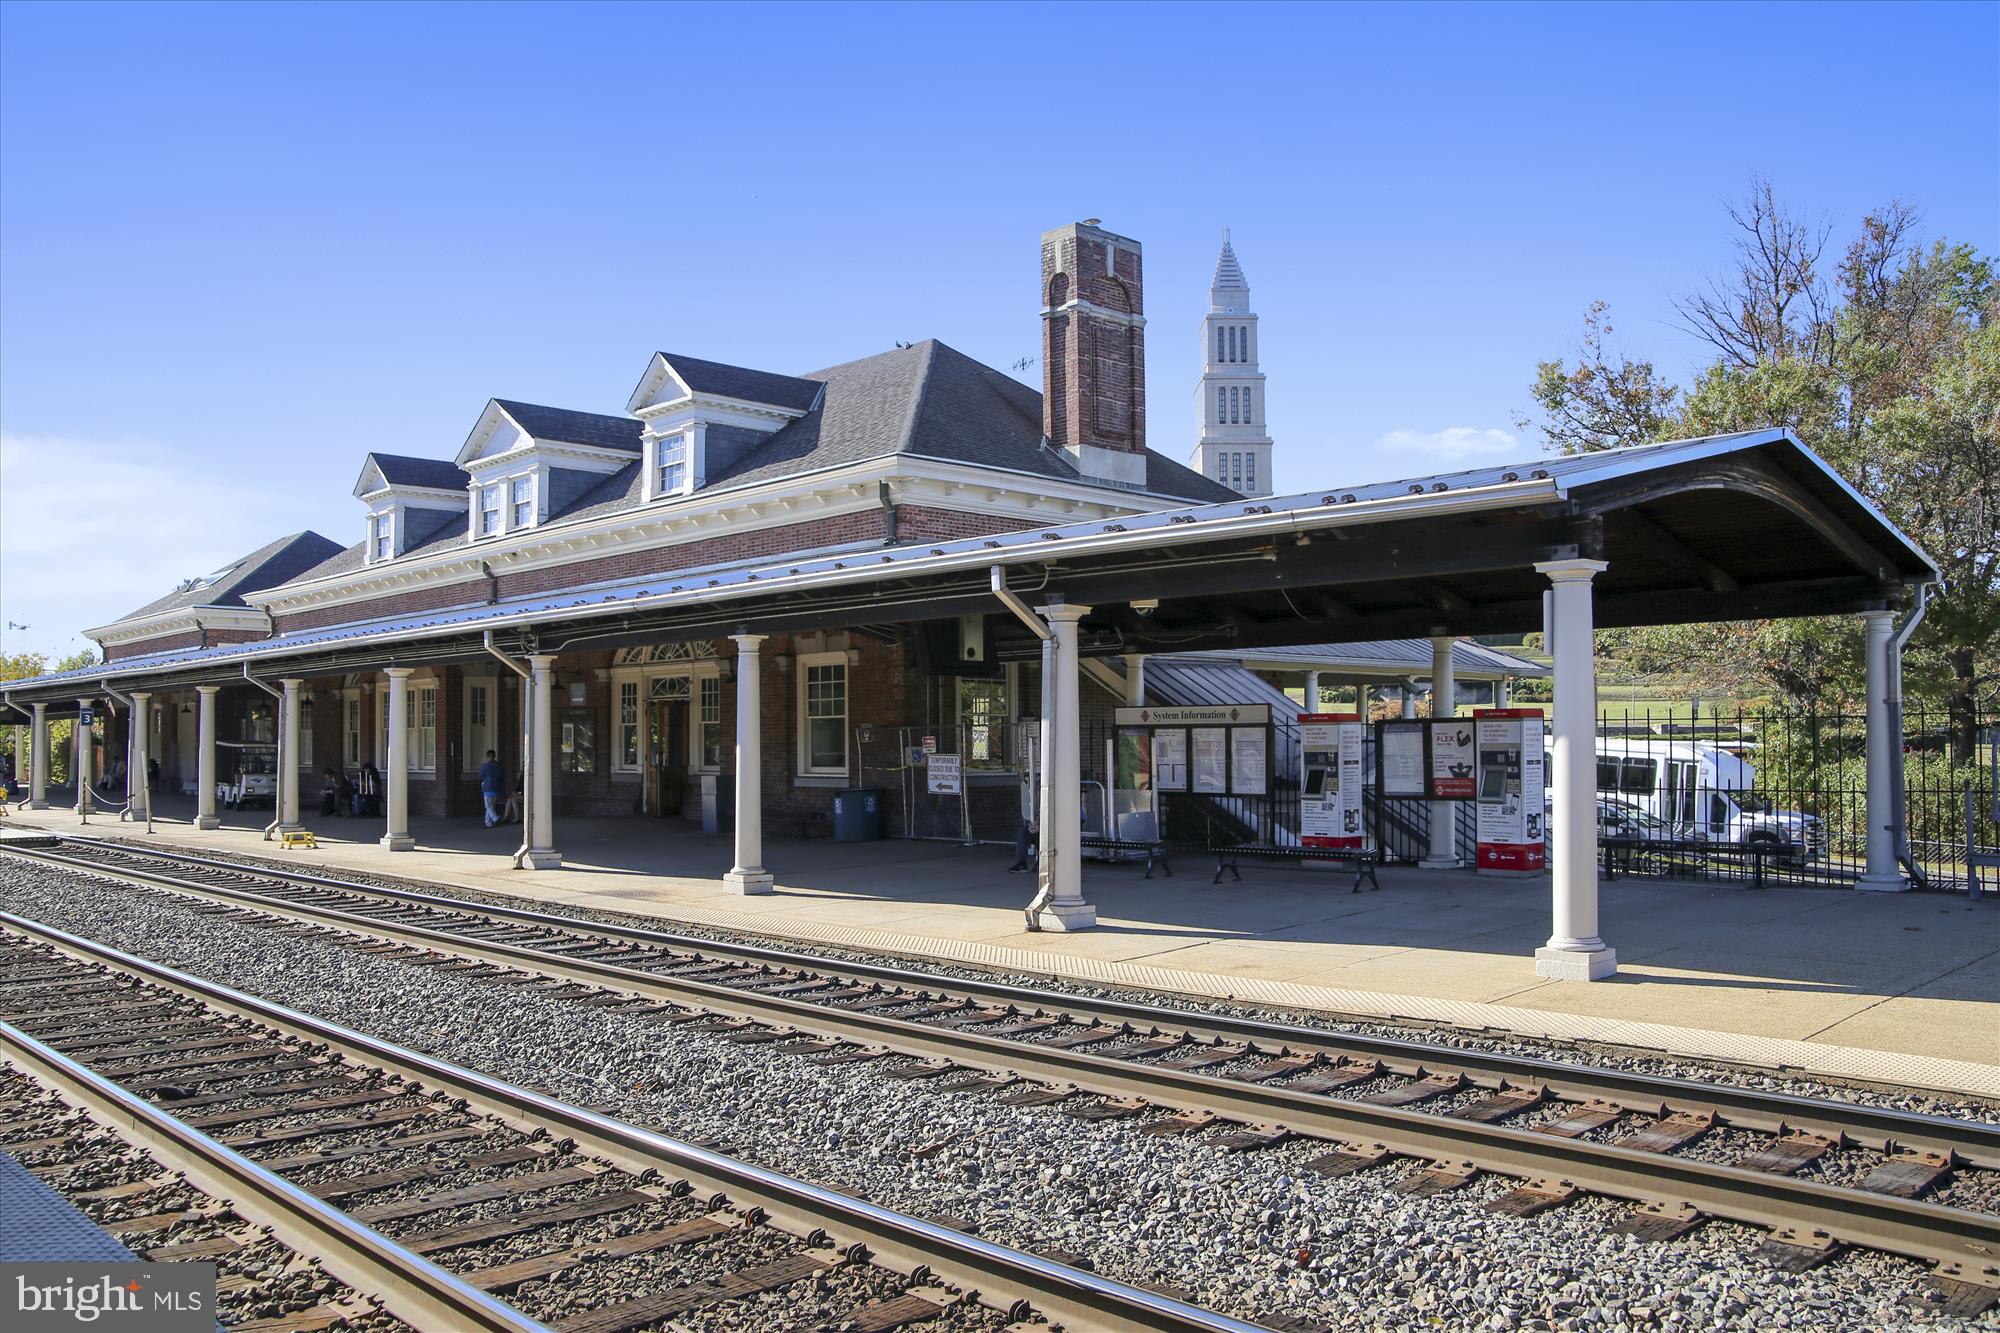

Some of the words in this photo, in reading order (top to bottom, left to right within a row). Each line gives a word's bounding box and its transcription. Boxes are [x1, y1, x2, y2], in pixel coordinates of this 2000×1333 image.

[84, 714, 91, 723] 3
[1153, 711, 1179, 722] System
[1181, 710, 1226, 720] Information
[945, 765, 953, 773] DUE
[929, 773, 959, 781] CONSTRUCTION
